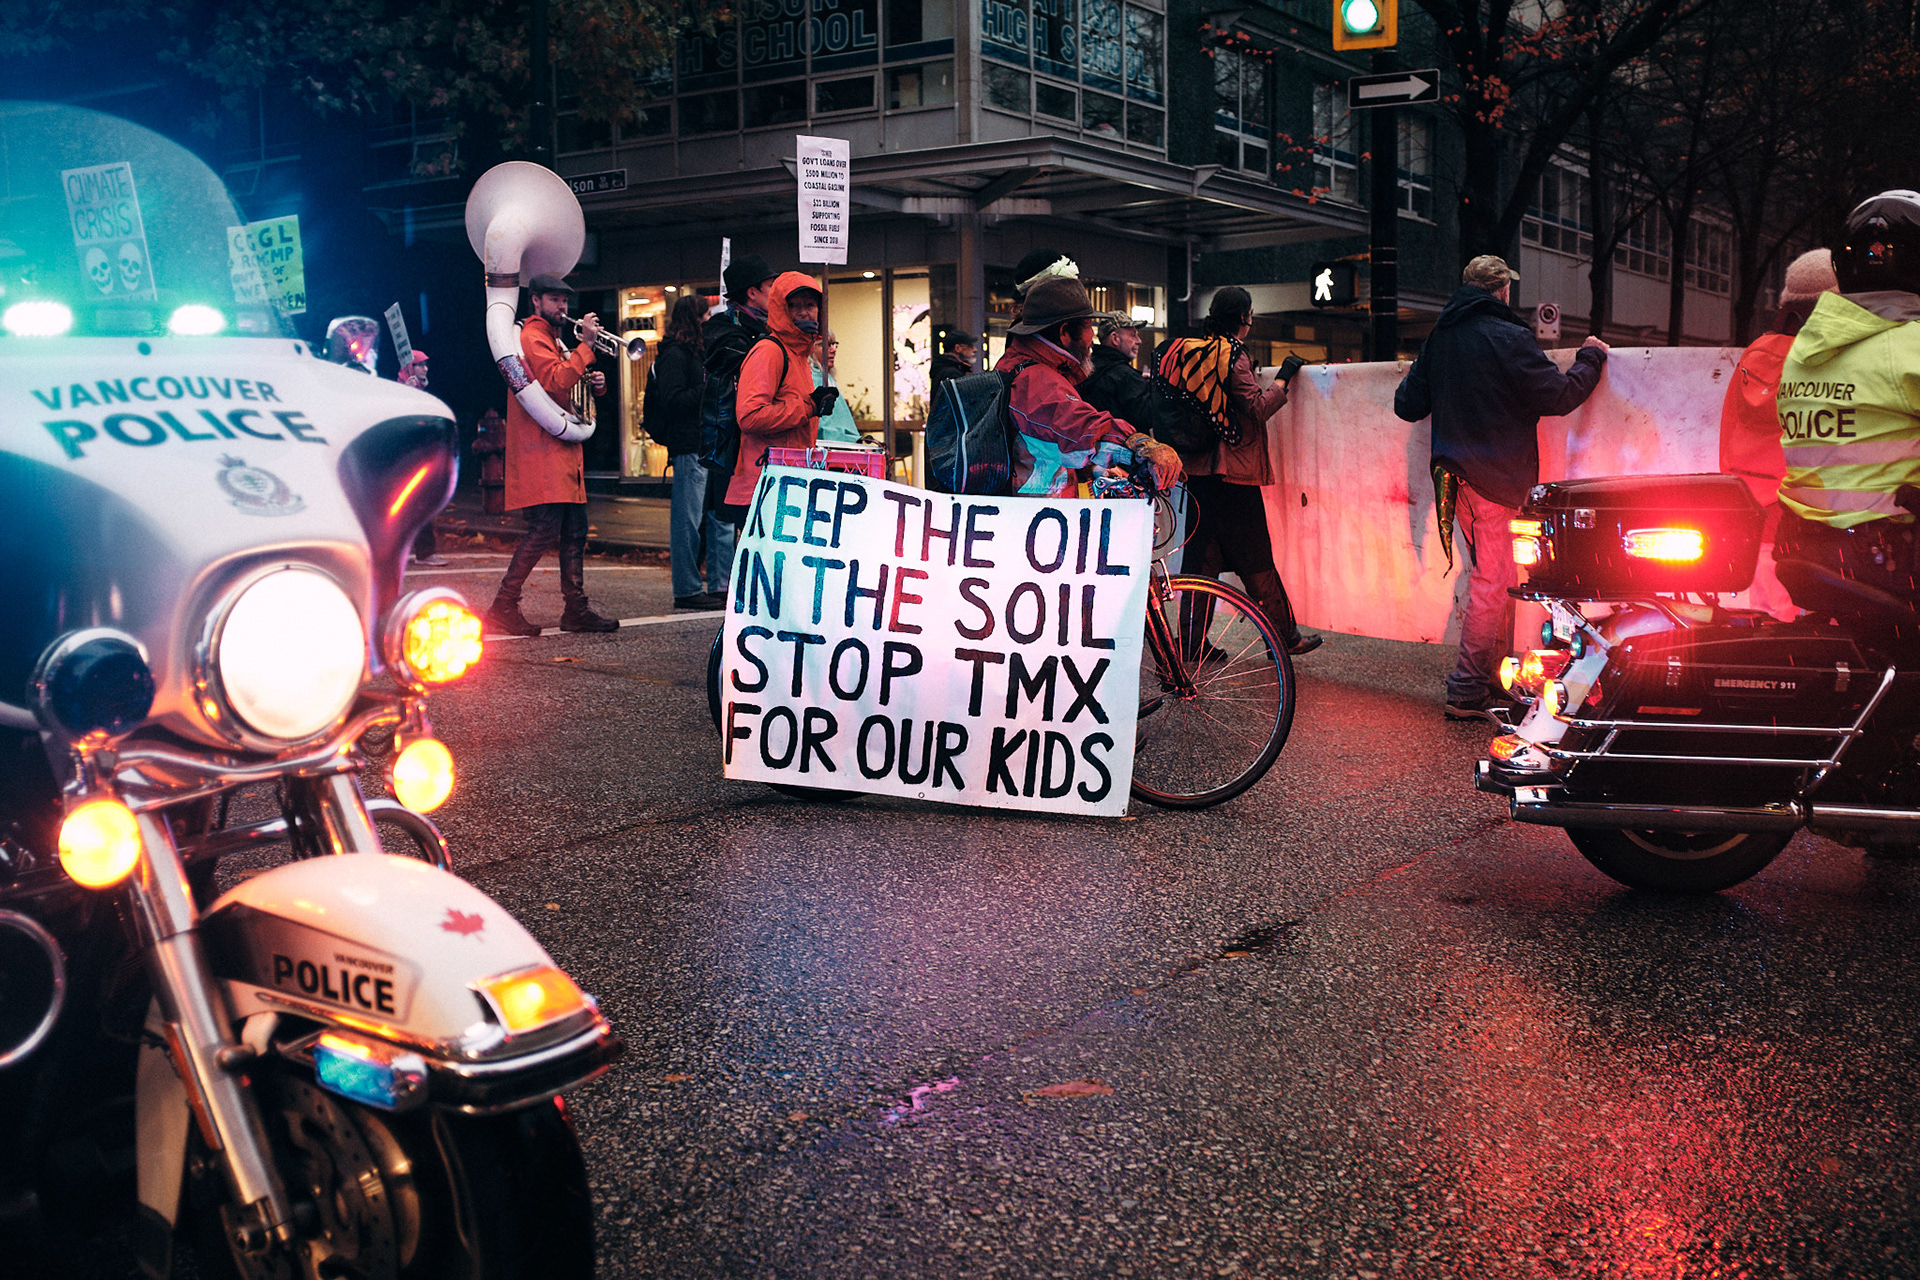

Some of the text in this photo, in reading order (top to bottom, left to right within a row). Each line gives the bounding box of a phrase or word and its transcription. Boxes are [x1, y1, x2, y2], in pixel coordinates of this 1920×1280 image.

[716, 9, 877, 68] SCHOOL
[981, 0, 1151, 85] HIGH SCHOOL
[820, 159, 835, 167] LOANS
[836, 160, 847, 168] OVER
[820, 170, 838, 179] MILLION
[67, 166, 130, 204] CLIMATE
[804, 181, 827, 190] COASTAL
[74, 202, 133, 239] CRISIS
[812, 211, 840, 220] SUPPORTING
[823, 199, 840, 208] BILLION
[811, 223, 827, 232] FOSSIL
[814, 235, 828, 244] SINCE
[625, 315, 657, 331] OPEN
[31, 376, 282, 411] VANCOUVER
[40, 408, 331, 460] POLICE
[748, 474, 1131, 576] KEEP THE OIL
[733, 548, 1116, 650] IN THE SOIL
[730, 625, 1111, 724] STOP TMX
[1714, 678, 1797, 690] EMERGENCY 911
[725, 701, 1115, 803] FOR OUR KIDS
[333, 953, 394, 974] VANCOUVER
[272, 953, 395, 1015] POLICE
